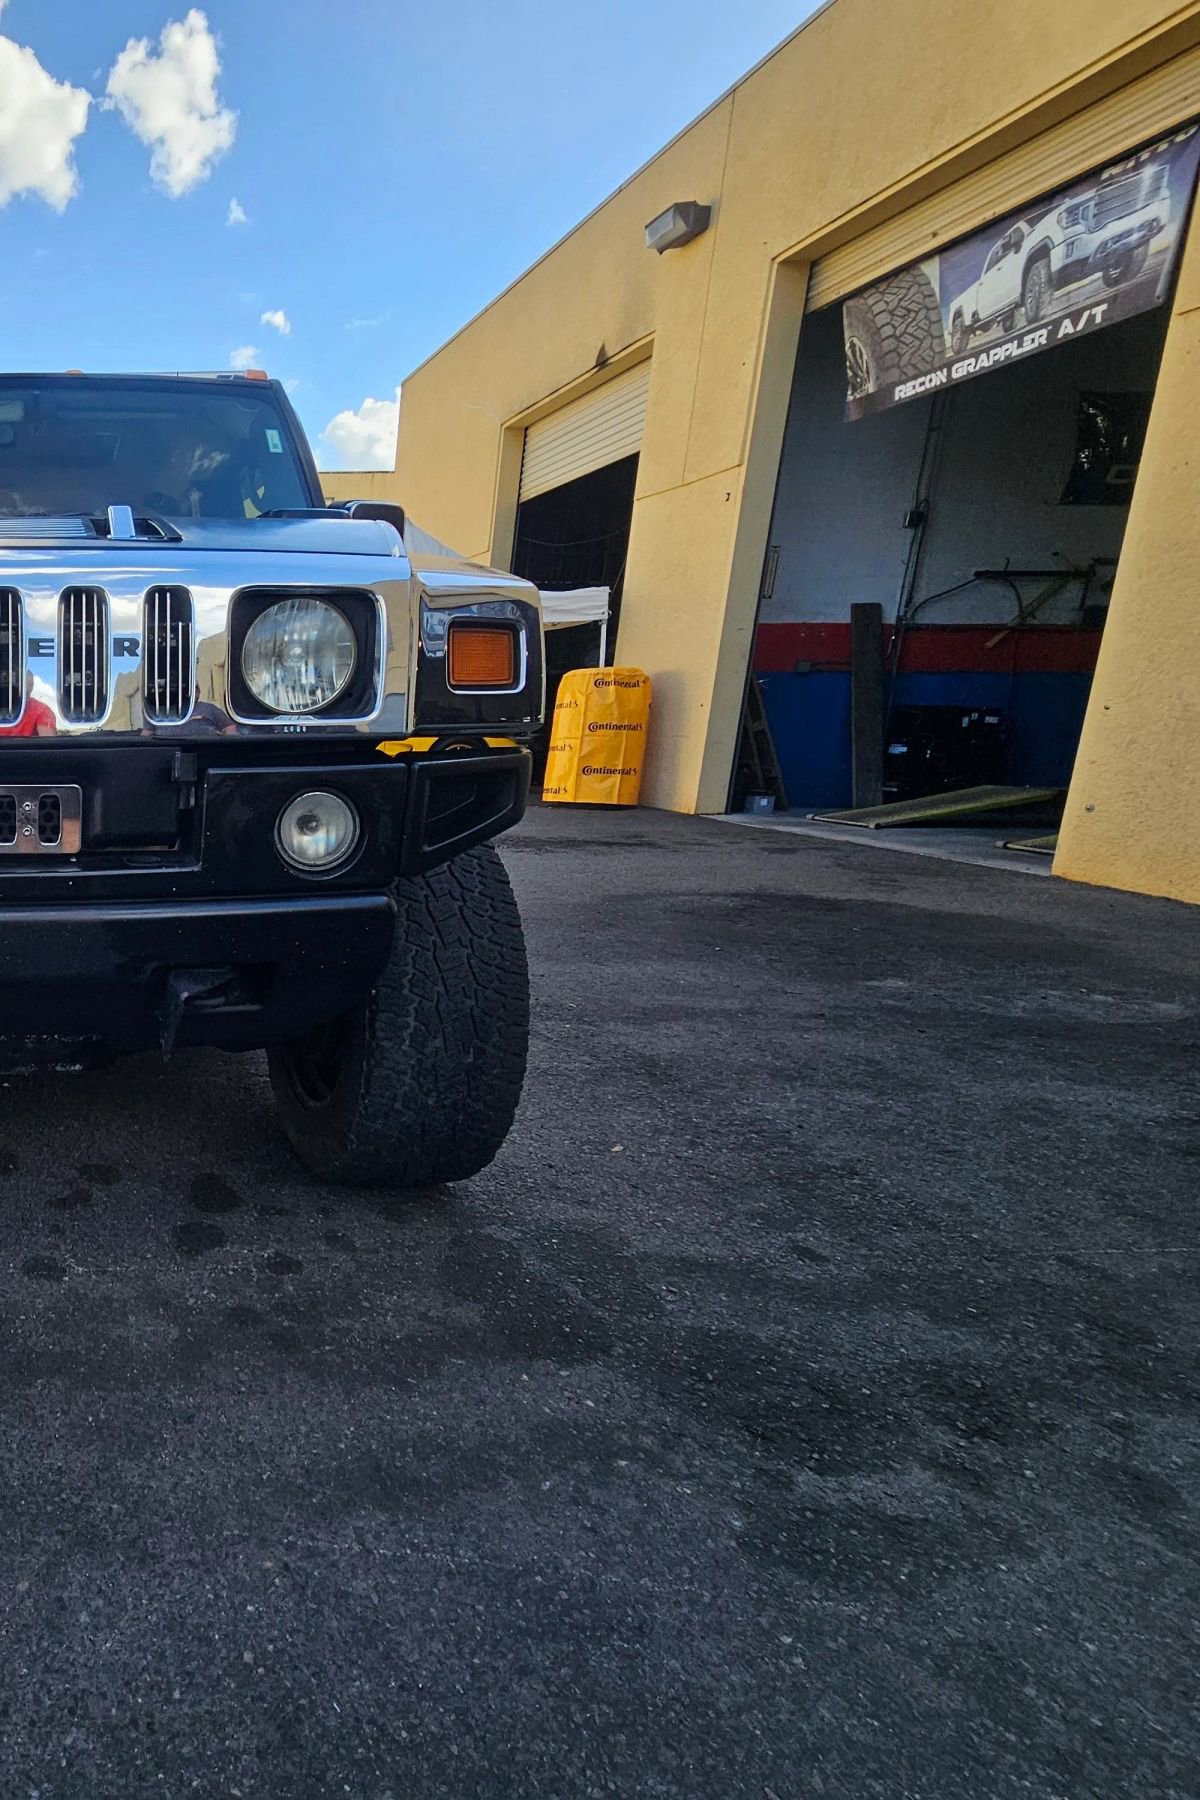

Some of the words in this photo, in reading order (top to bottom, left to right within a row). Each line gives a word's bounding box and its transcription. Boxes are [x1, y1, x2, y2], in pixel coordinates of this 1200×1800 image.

[894, 367, 948, 401] RECON
[951, 329, 1049, 380] GRAPPLER
[1057, 303, 1109, 339] A/T
[588, 721, 639, 733] Continental
[582, 765, 632, 777] Continental
